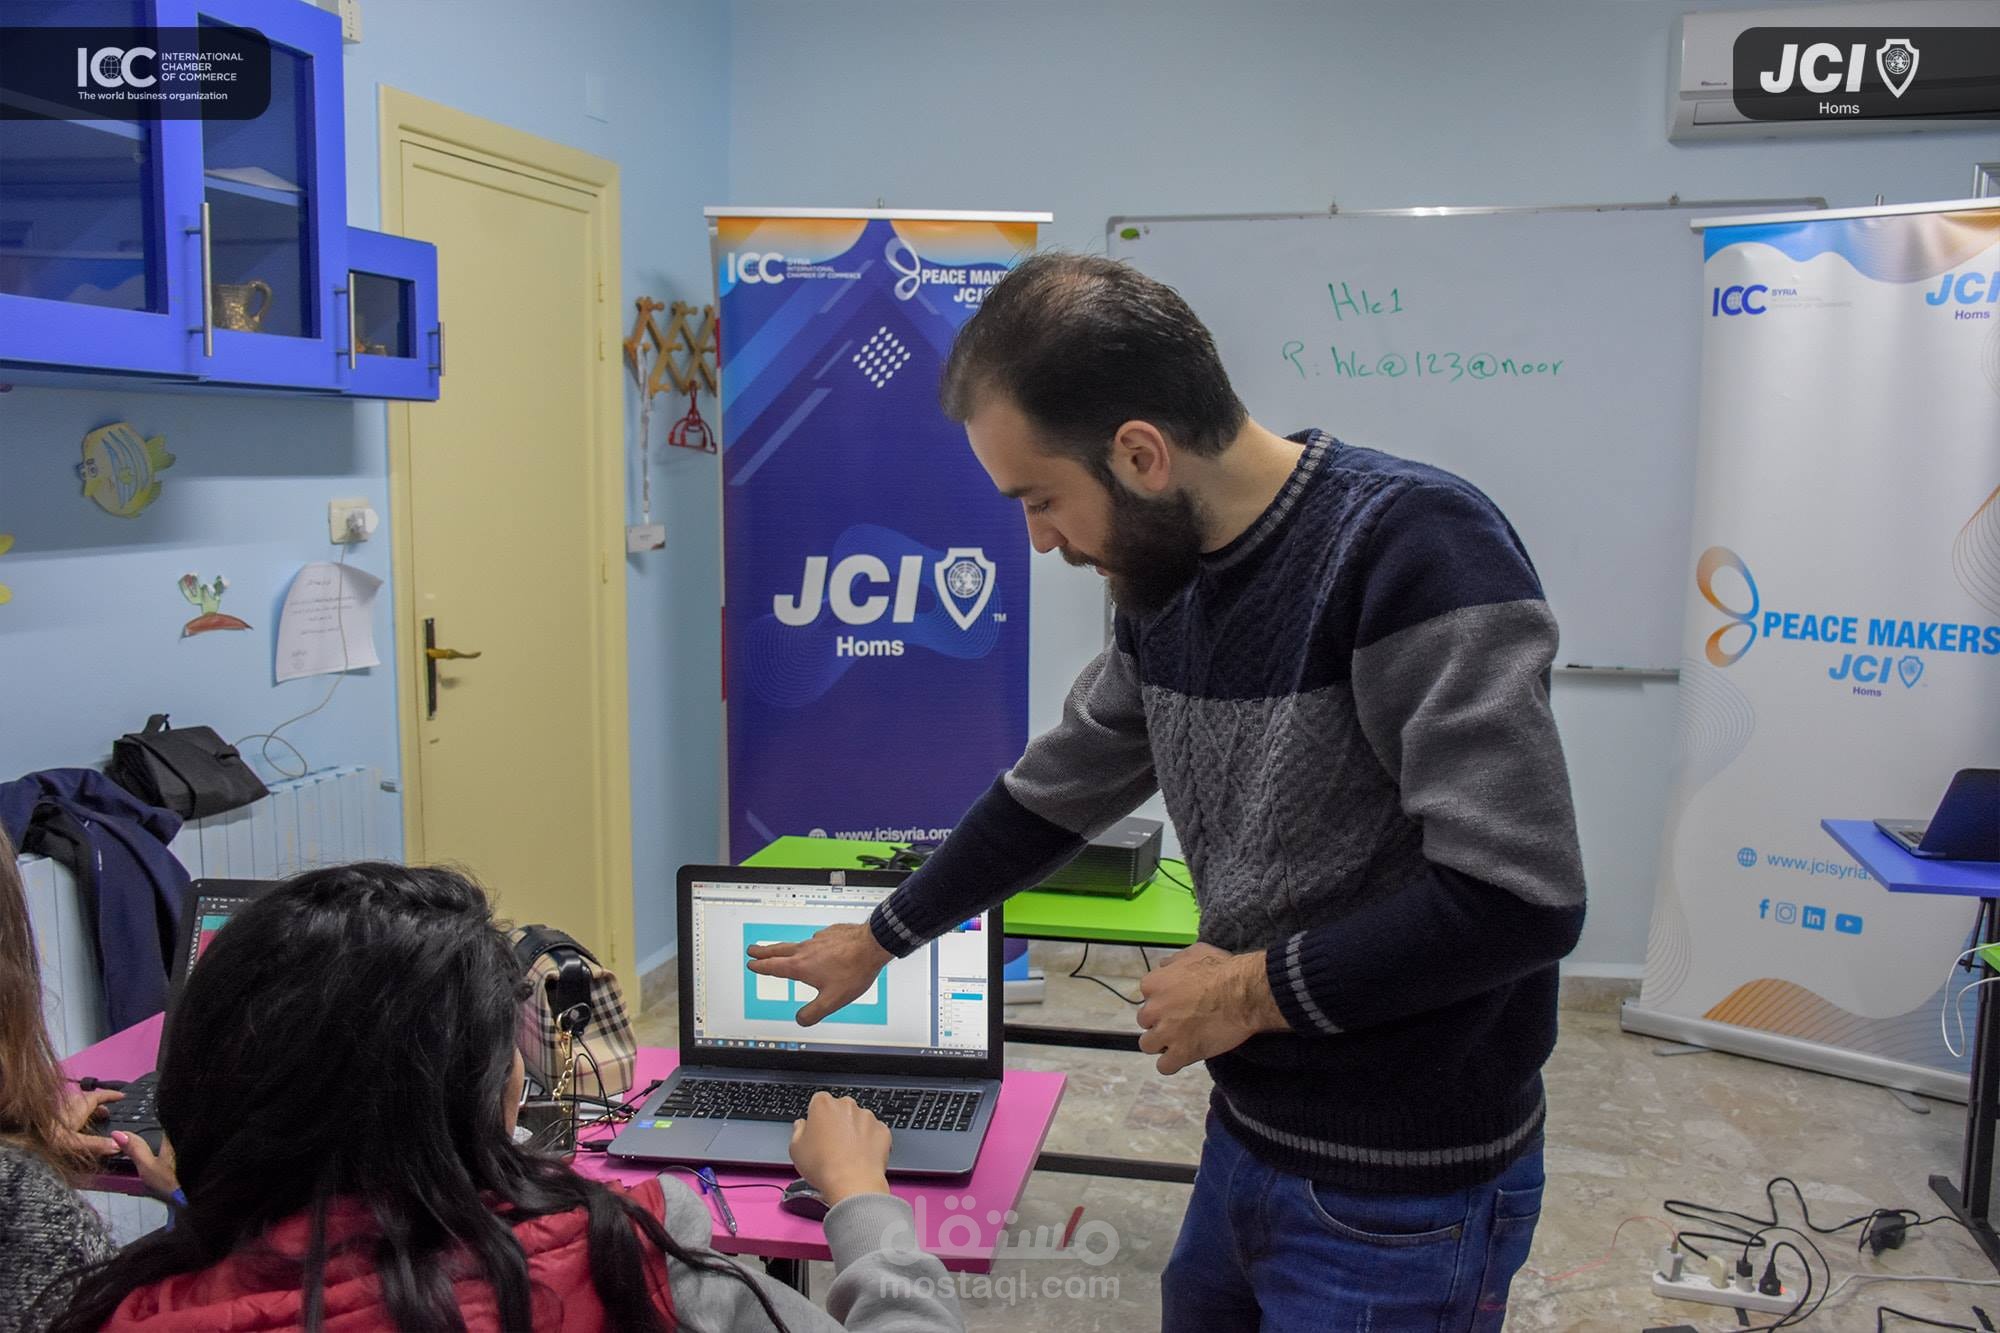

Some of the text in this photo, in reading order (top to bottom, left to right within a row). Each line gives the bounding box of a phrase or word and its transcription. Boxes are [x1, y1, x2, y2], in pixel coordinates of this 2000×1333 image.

[727, 251, 785, 285] ICC
[921, 268, 967, 285] PEACE
[953, 287, 983, 303] JCI
[1712, 284, 1769, 317] ICC
[1771, 288, 1798, 297] SYRIA
[1925, 271, 2000, 306] JCI
[1954, 309, 1990, 320] Homs
[773, 554, 923, 627] JCI
[993, 612, 1007, 622] TM
[836, 635, 905, 657] Homs
[1762, 611, 2000, 656] PEACE MAKERS
[1828, 653, 1893, 684] JCI
[1852, 686, 1883, 698] Homs
[1767, 853, 1875, 881] www.jcisyria.
